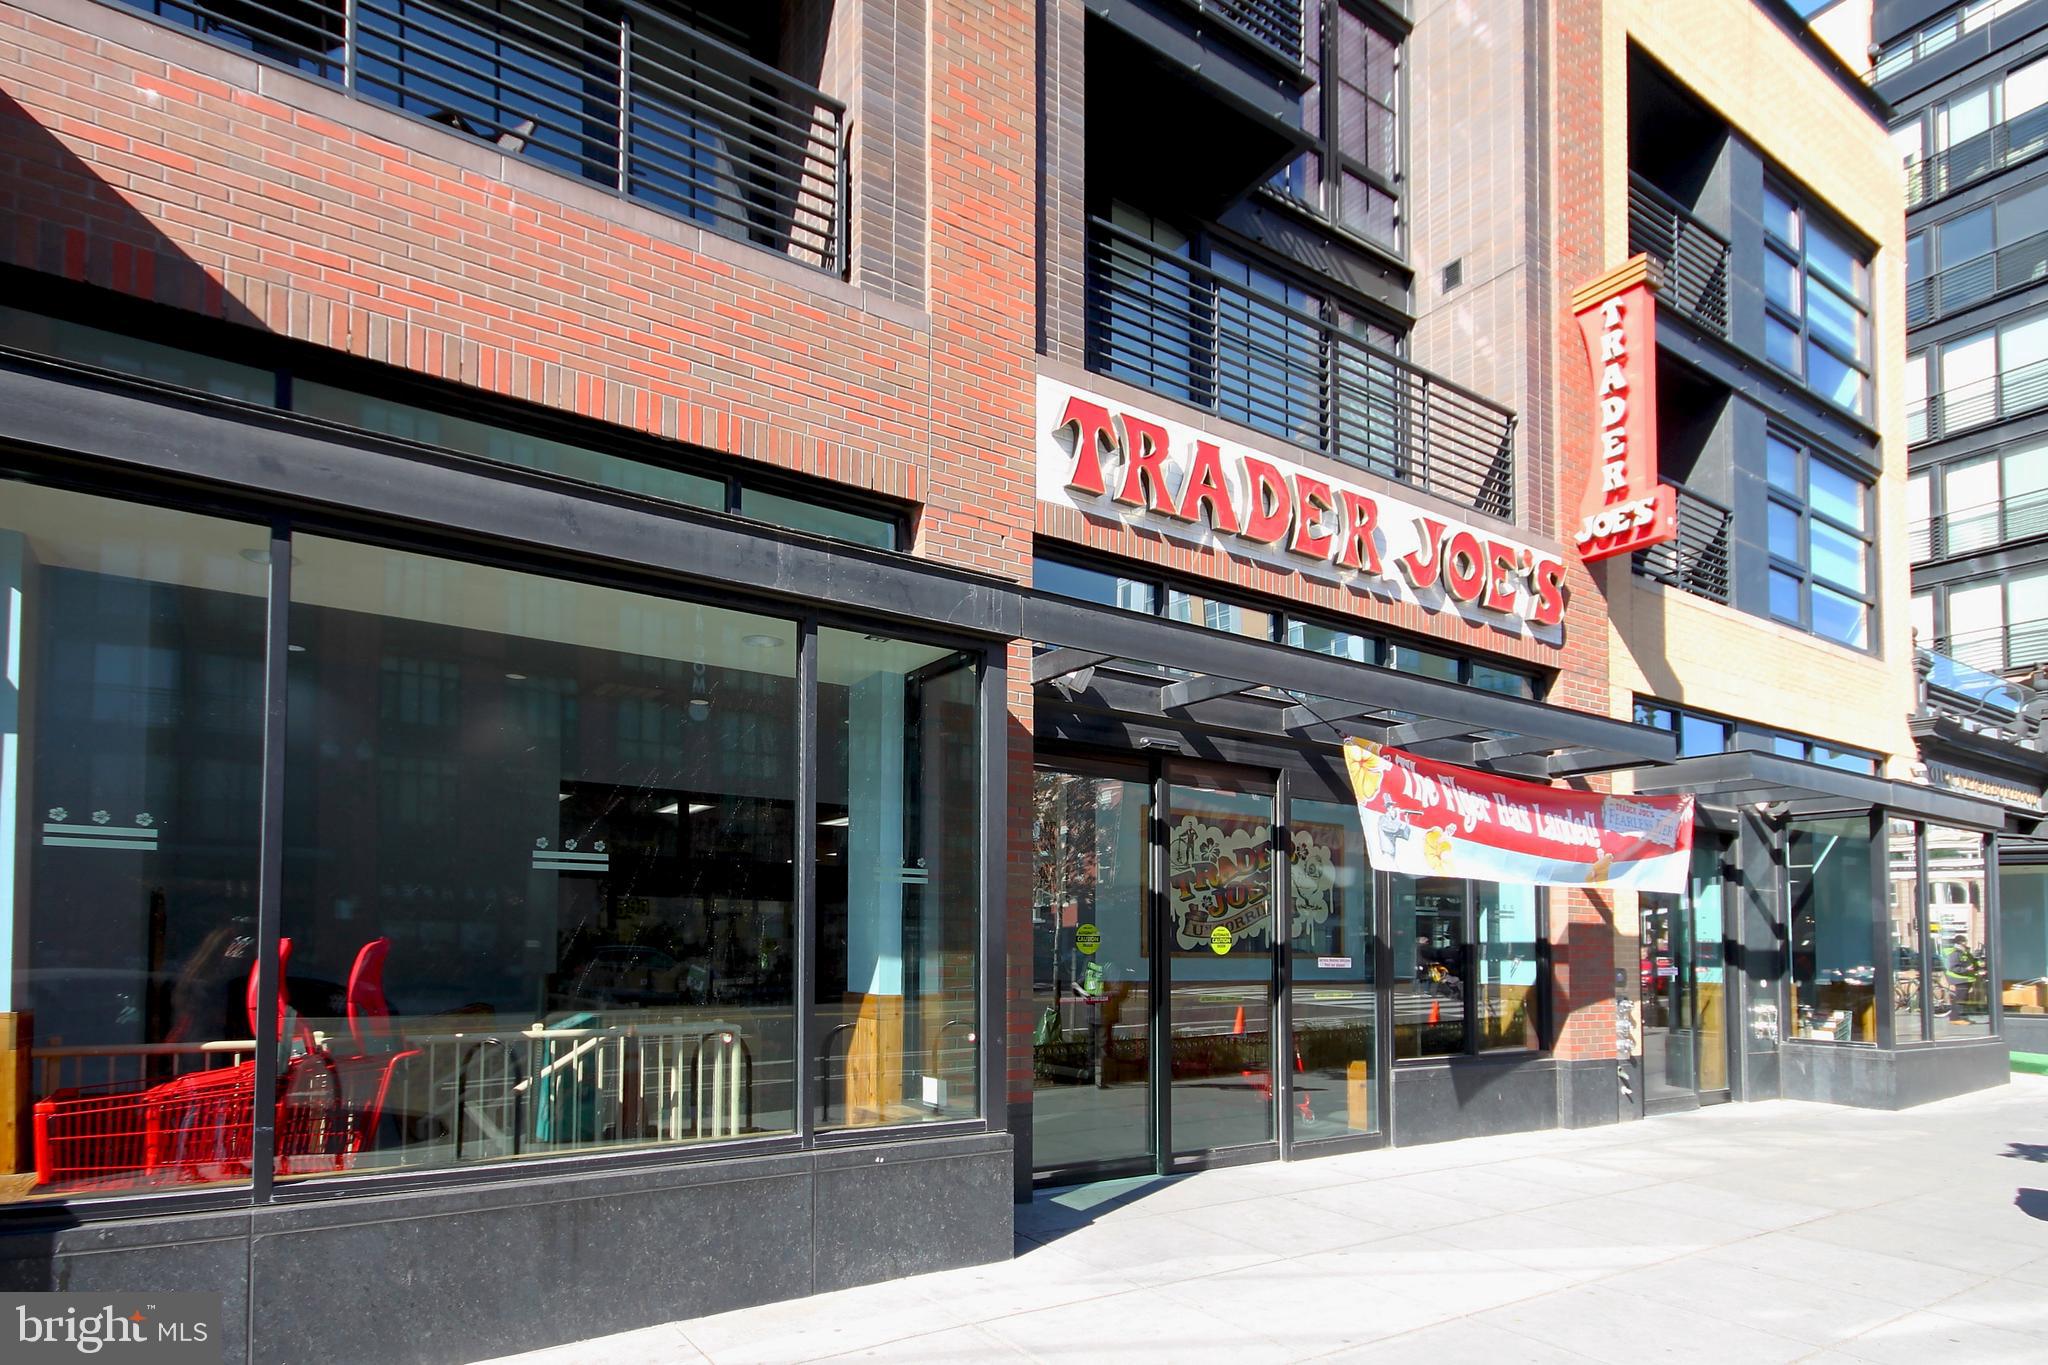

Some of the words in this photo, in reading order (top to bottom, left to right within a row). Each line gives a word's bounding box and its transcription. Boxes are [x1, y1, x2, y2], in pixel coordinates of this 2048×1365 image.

[1600, 295, 1627, 493] TRADER
[1056, 396, 1384, 576] TRADER
[1399, 515, 1569, 627] JOE'S
[1574, 496, 1656, 542] JOE'S
[1395, 754, 1440, 808] The
[1437, 774, 1492, 833] Flyer
[1492, 792, 1532, 834] Has
